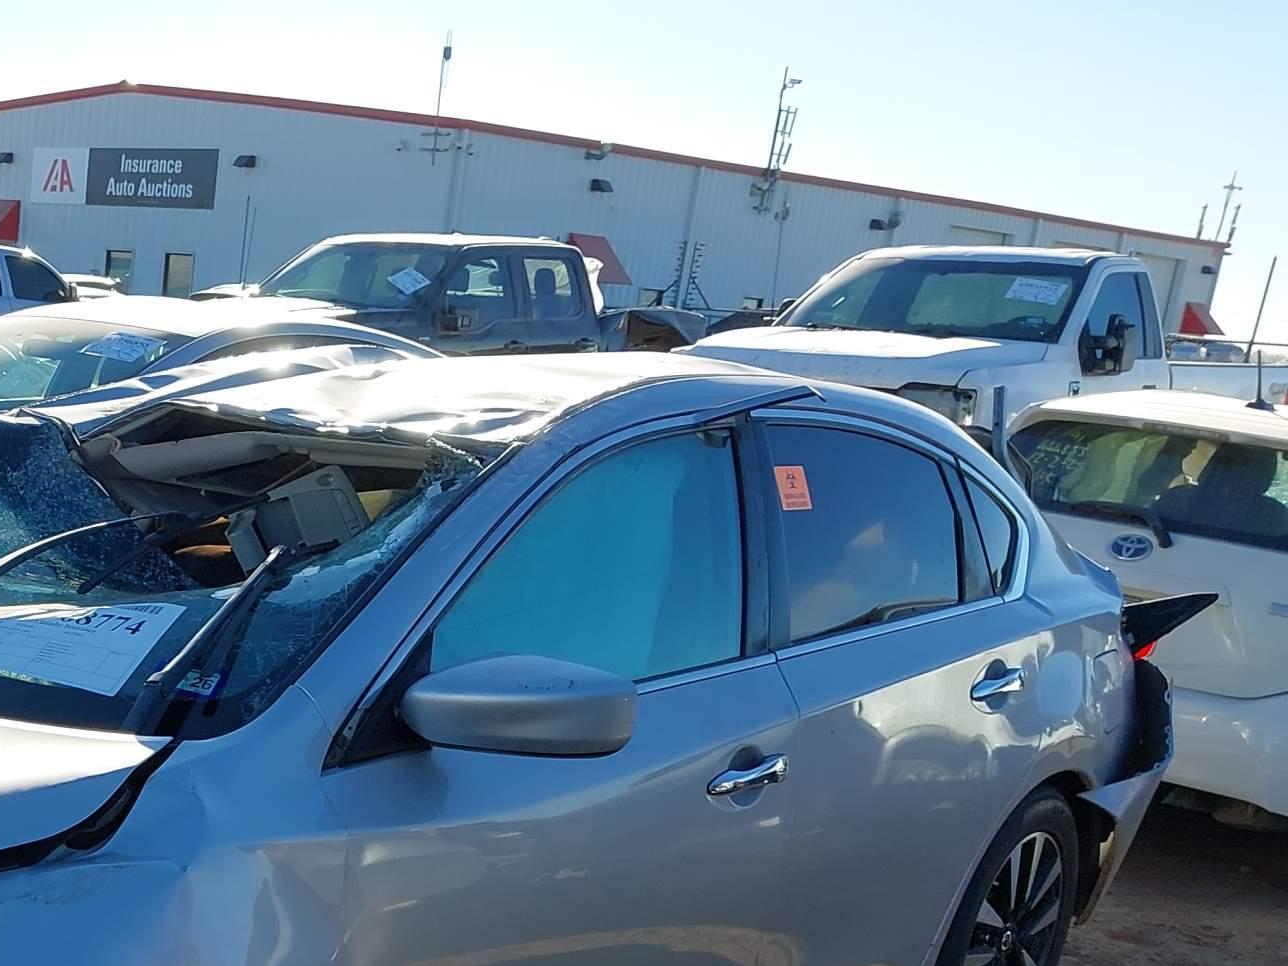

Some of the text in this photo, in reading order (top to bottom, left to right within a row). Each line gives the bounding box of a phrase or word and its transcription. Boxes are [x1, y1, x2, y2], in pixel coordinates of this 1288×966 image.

[120, 153, 183, 174] Insurance
[106, 177, 193, 199] Auto Auctions
[60, 612, 147, 635] 8774
[190, 676, 214, 690] 26
